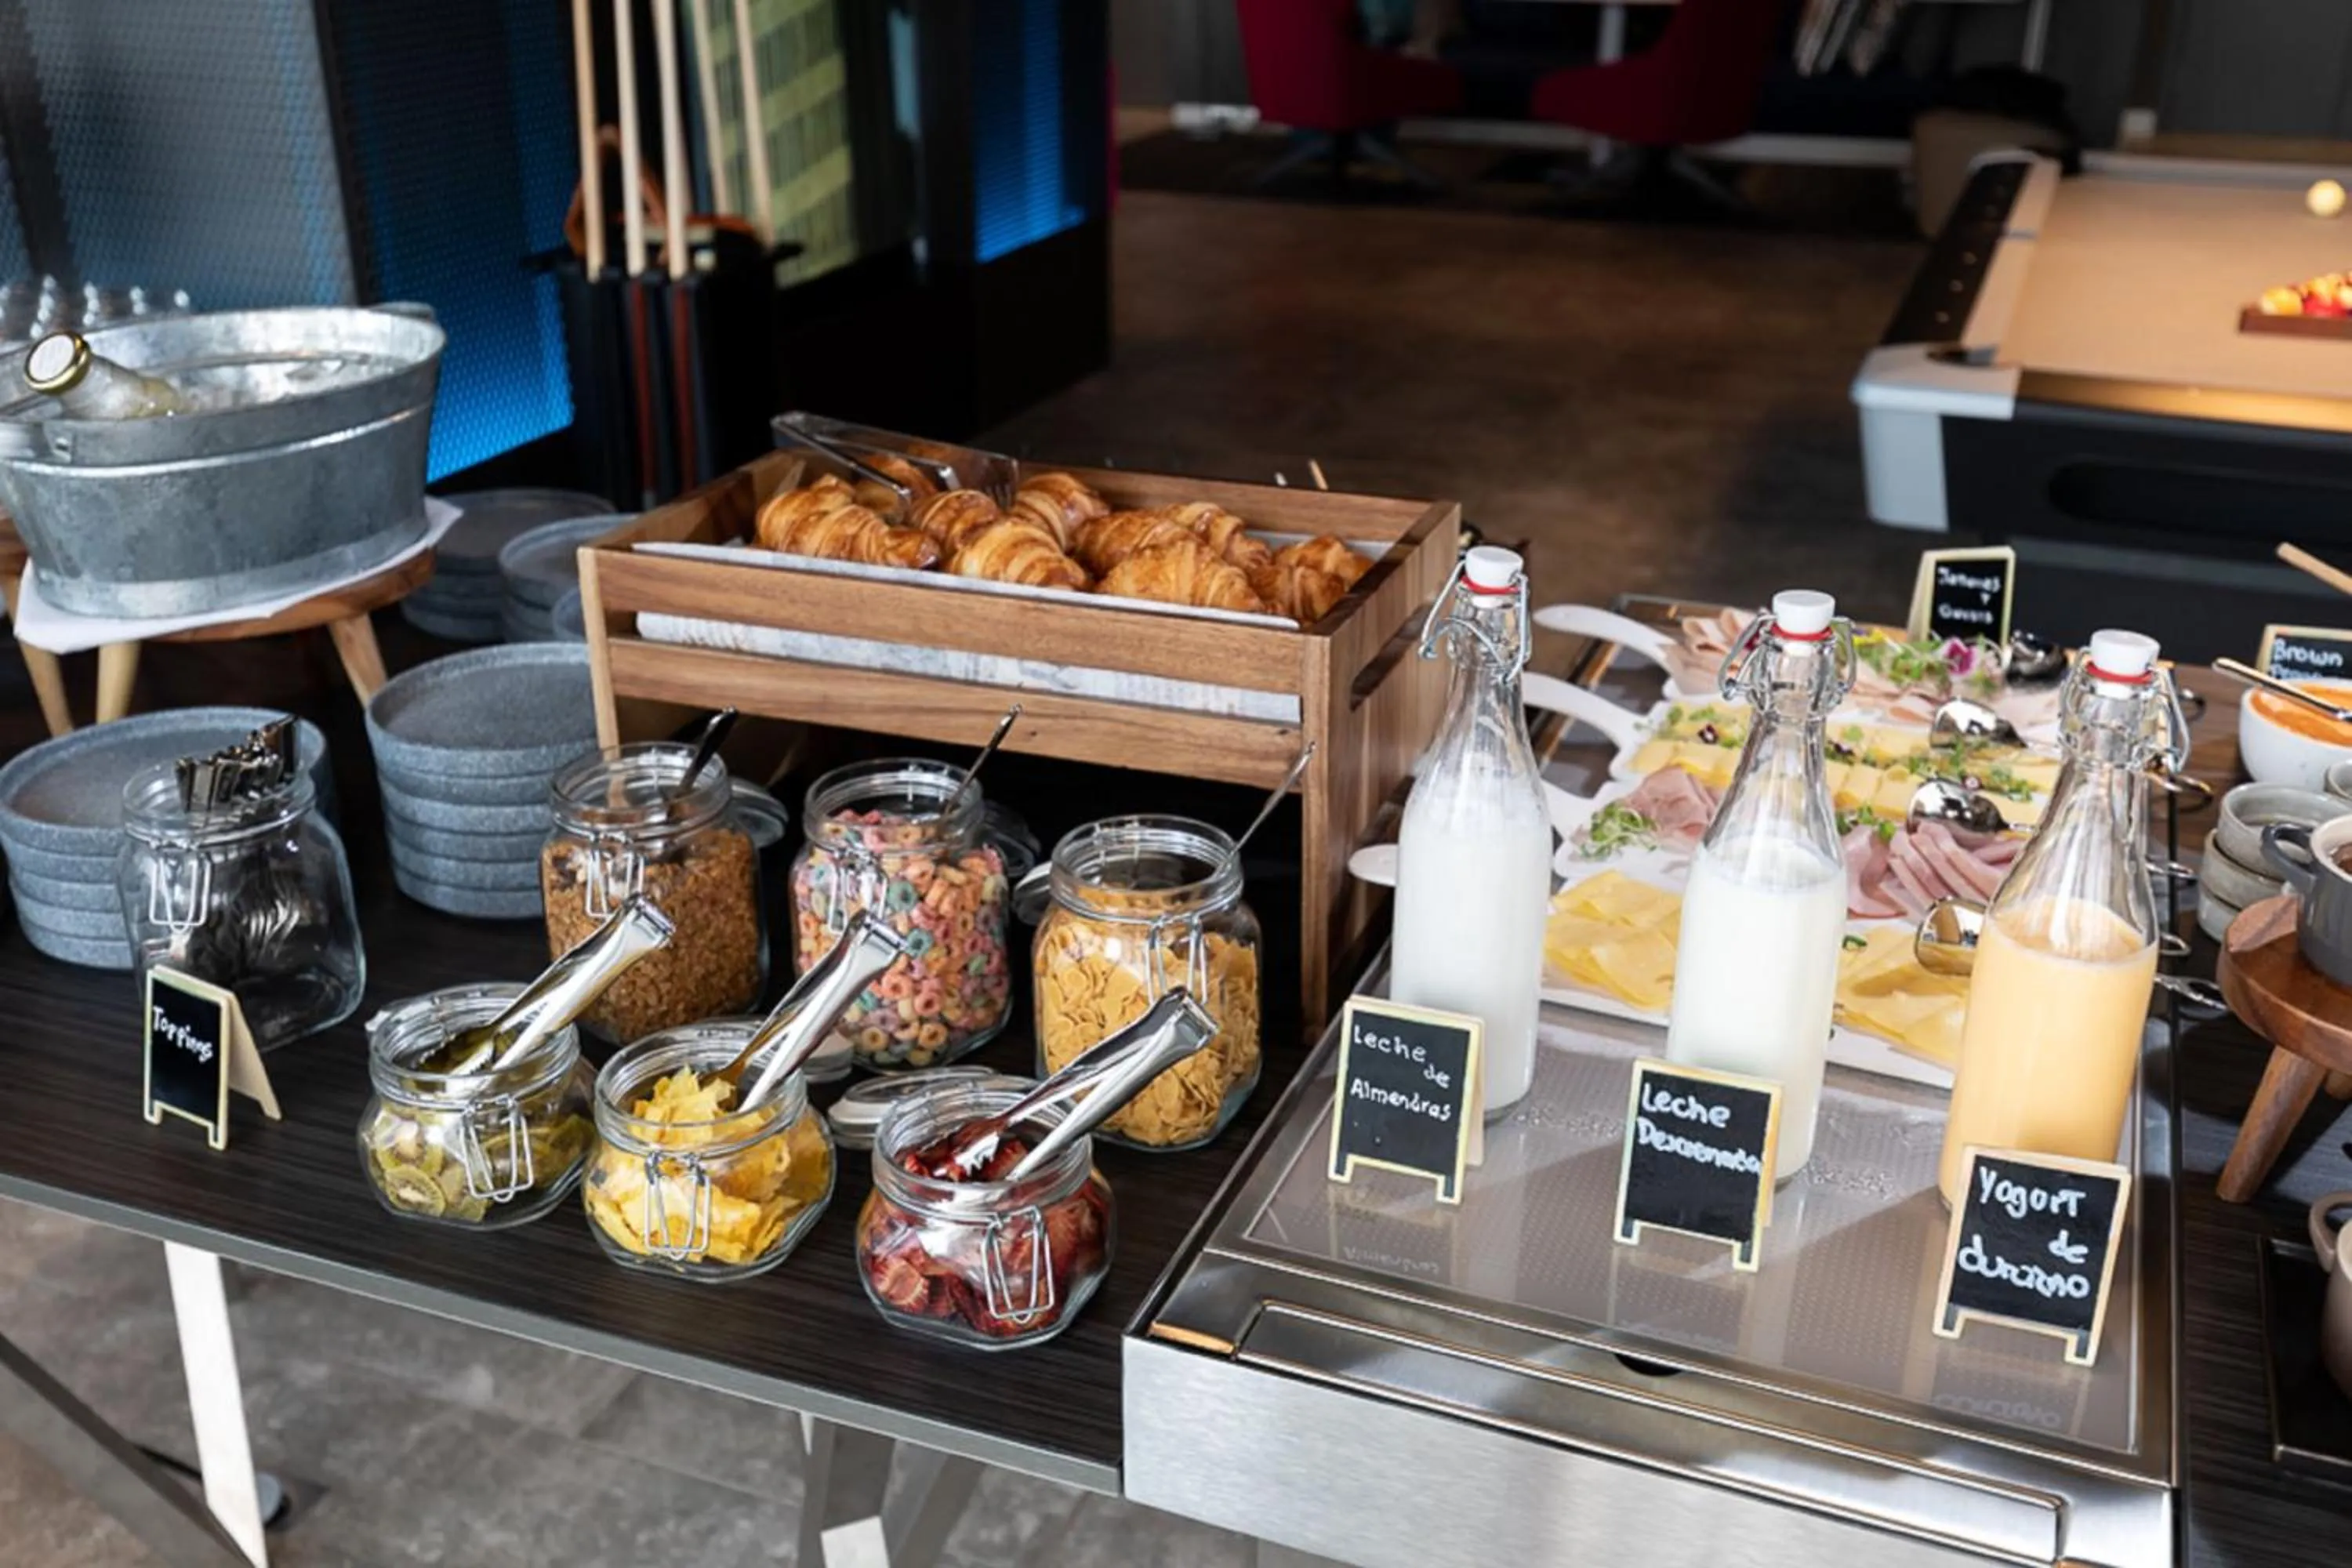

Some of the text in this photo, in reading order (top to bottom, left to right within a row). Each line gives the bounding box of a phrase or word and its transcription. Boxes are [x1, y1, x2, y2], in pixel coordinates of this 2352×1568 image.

[2274, 637, 2343, 668] Brown
[152, 1005, 213, 1063] Toppings
[1353, 1024, 1451, 1089] Leche de
[1350, 1076, 1452, 1122] Almendras
[1642, 1082, 1731, 1128] Leche
[2048, 1229, 2089, 1264] de
